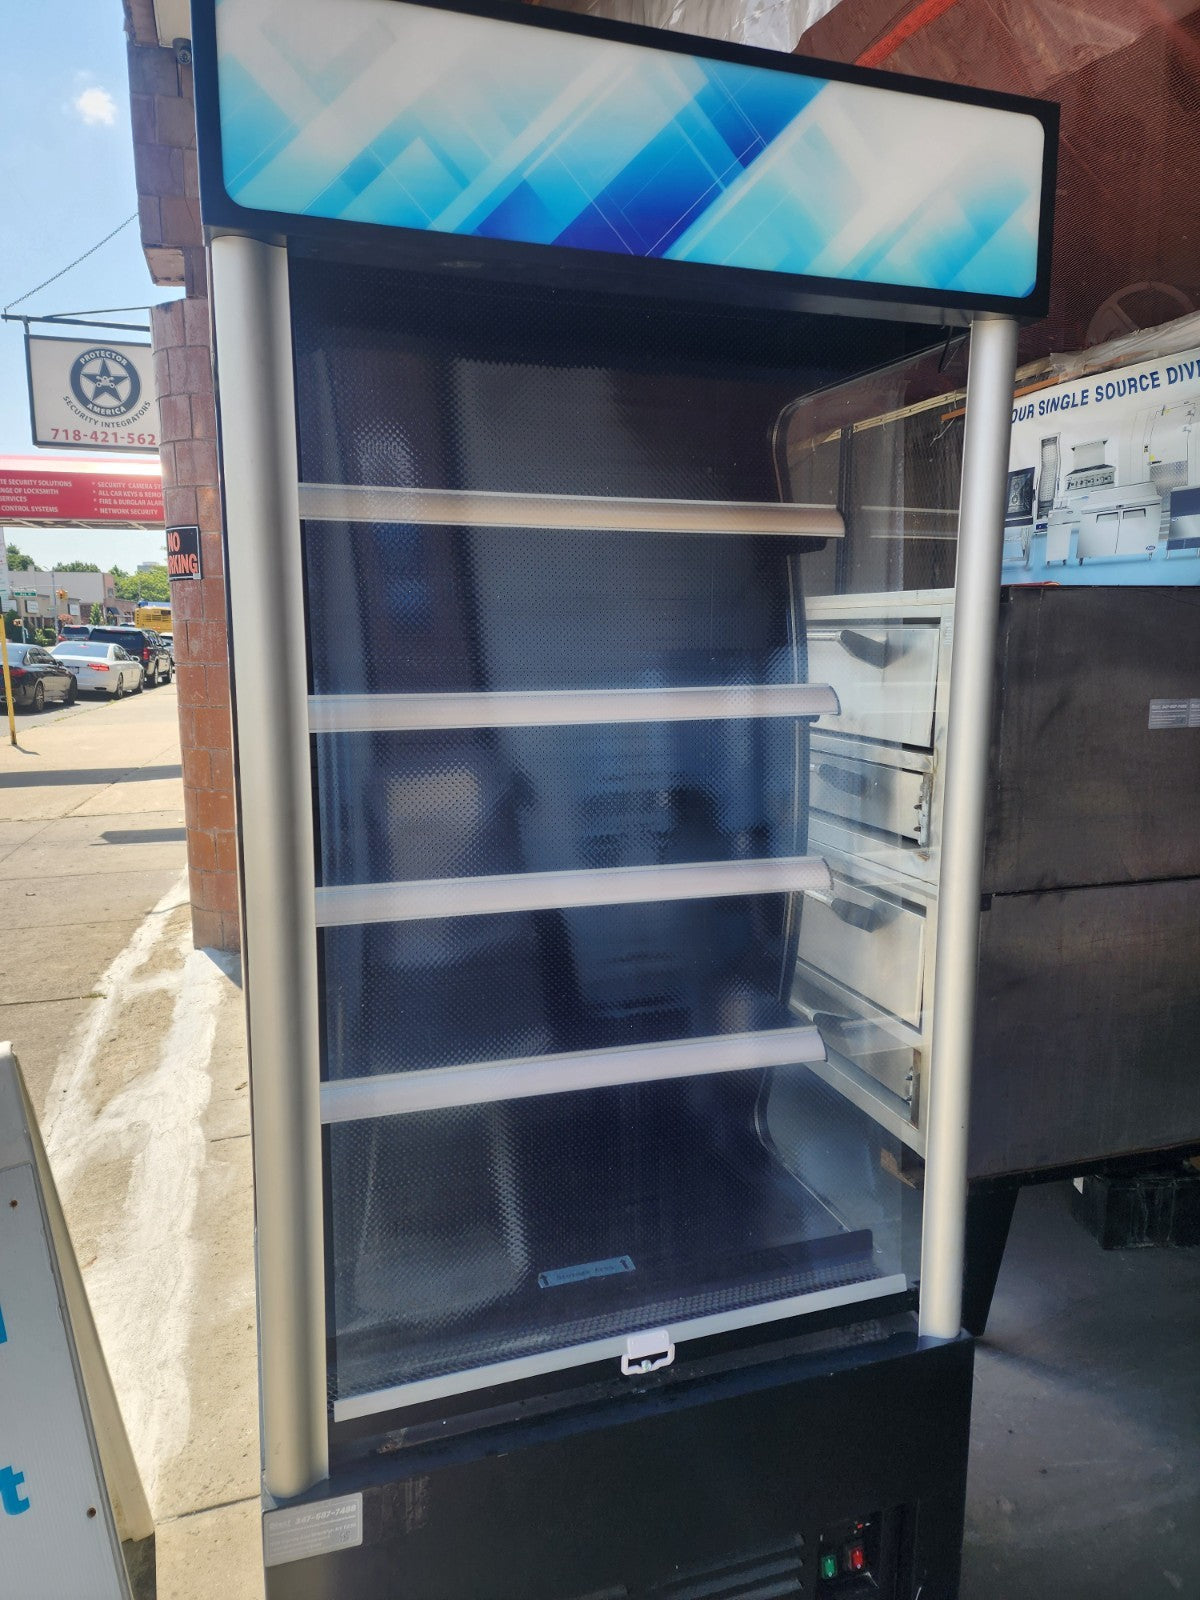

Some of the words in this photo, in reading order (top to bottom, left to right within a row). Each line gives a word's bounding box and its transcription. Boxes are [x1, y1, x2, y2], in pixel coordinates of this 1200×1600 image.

[79, 350, 128, 366] PROTECTOR
[1038, 389, 1089, 416] SINGLE
[1095, 371, 1161, 403] SOURCE
[63, 395, 99, 426] SECURITY
[101, 400, 151, 428] INTEGRATORS
[86, 403, 127, 416] AMERICA
[168, 531, 181, 553] NO
